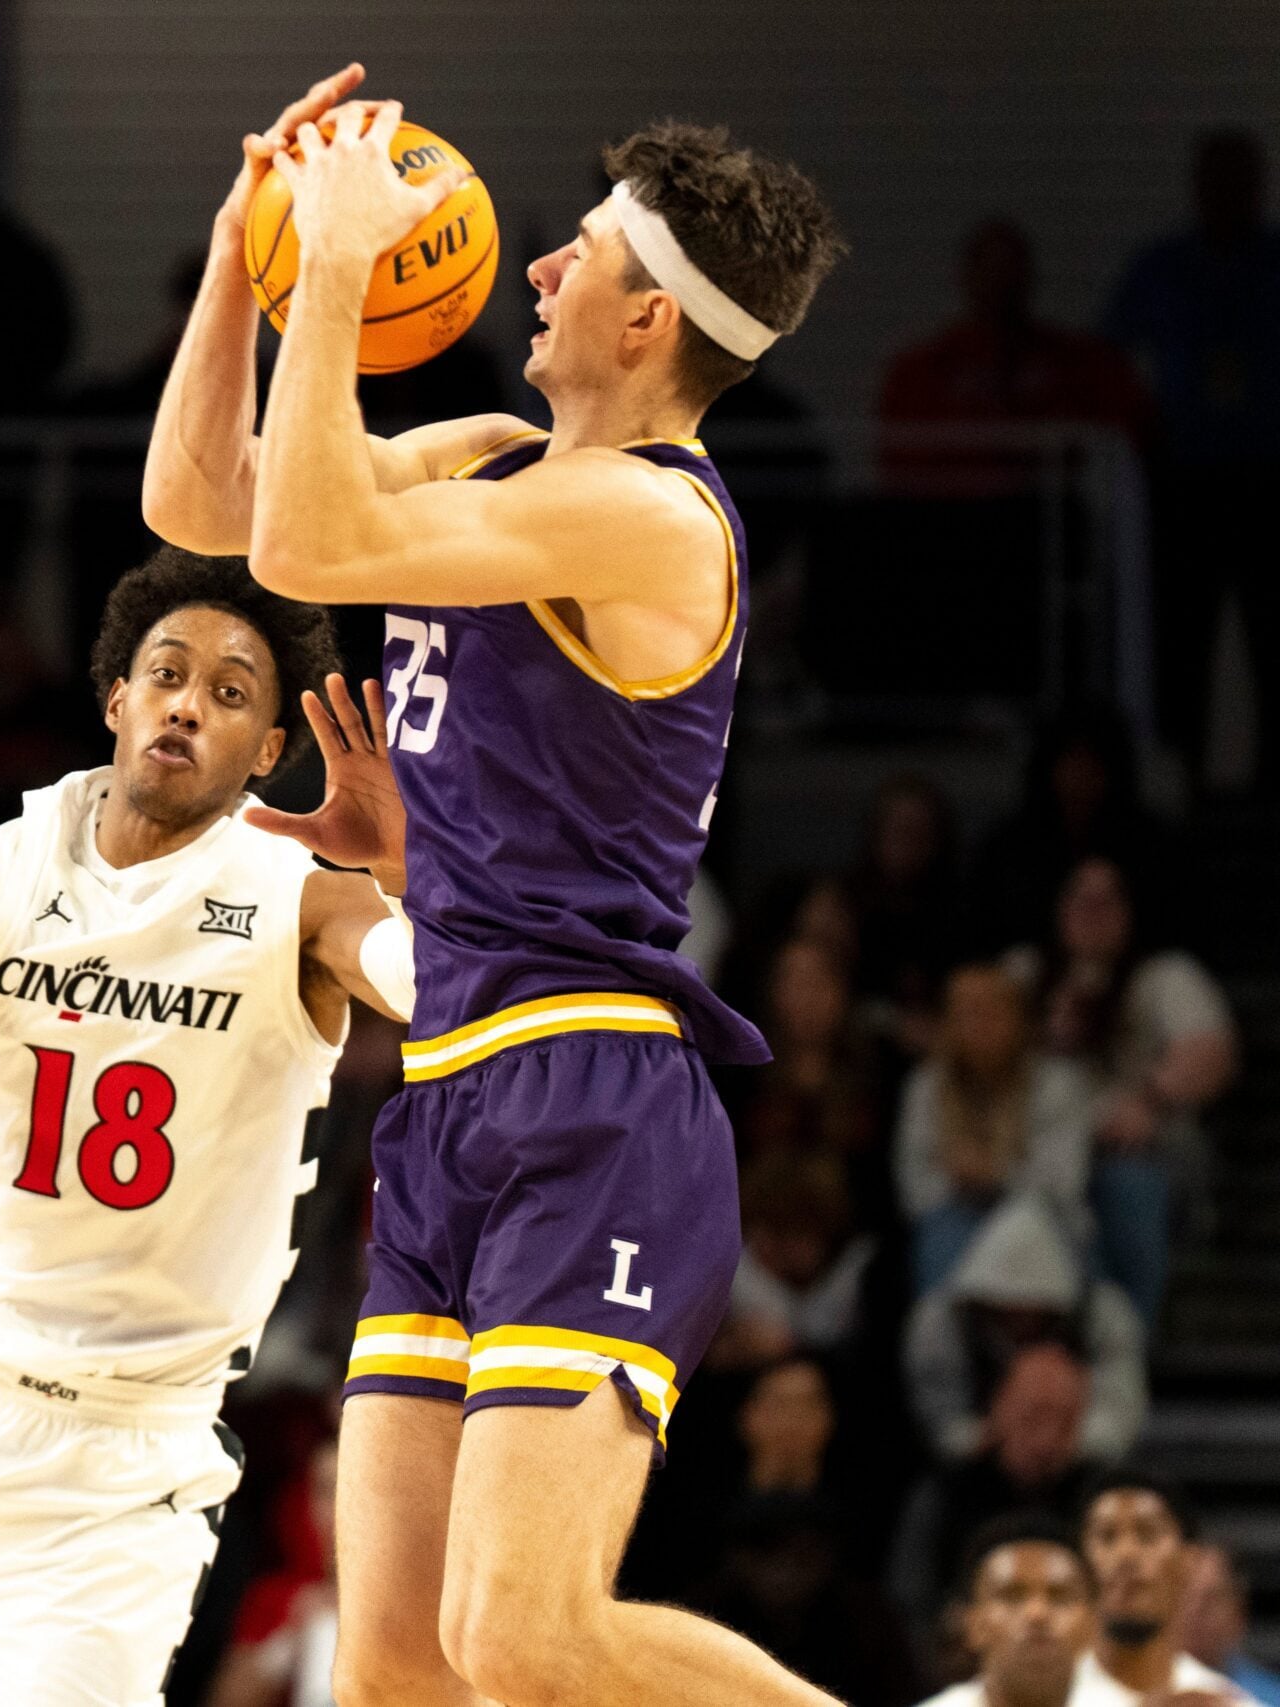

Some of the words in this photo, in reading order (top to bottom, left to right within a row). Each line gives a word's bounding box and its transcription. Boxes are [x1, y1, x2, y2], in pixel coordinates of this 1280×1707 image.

[393, 215, 468, 285] EVO
[13, 1043, 177, 1211] 18
[603, 1238, 653, 1312] L
[18, 1374, 80, 1402] BEARCATS
